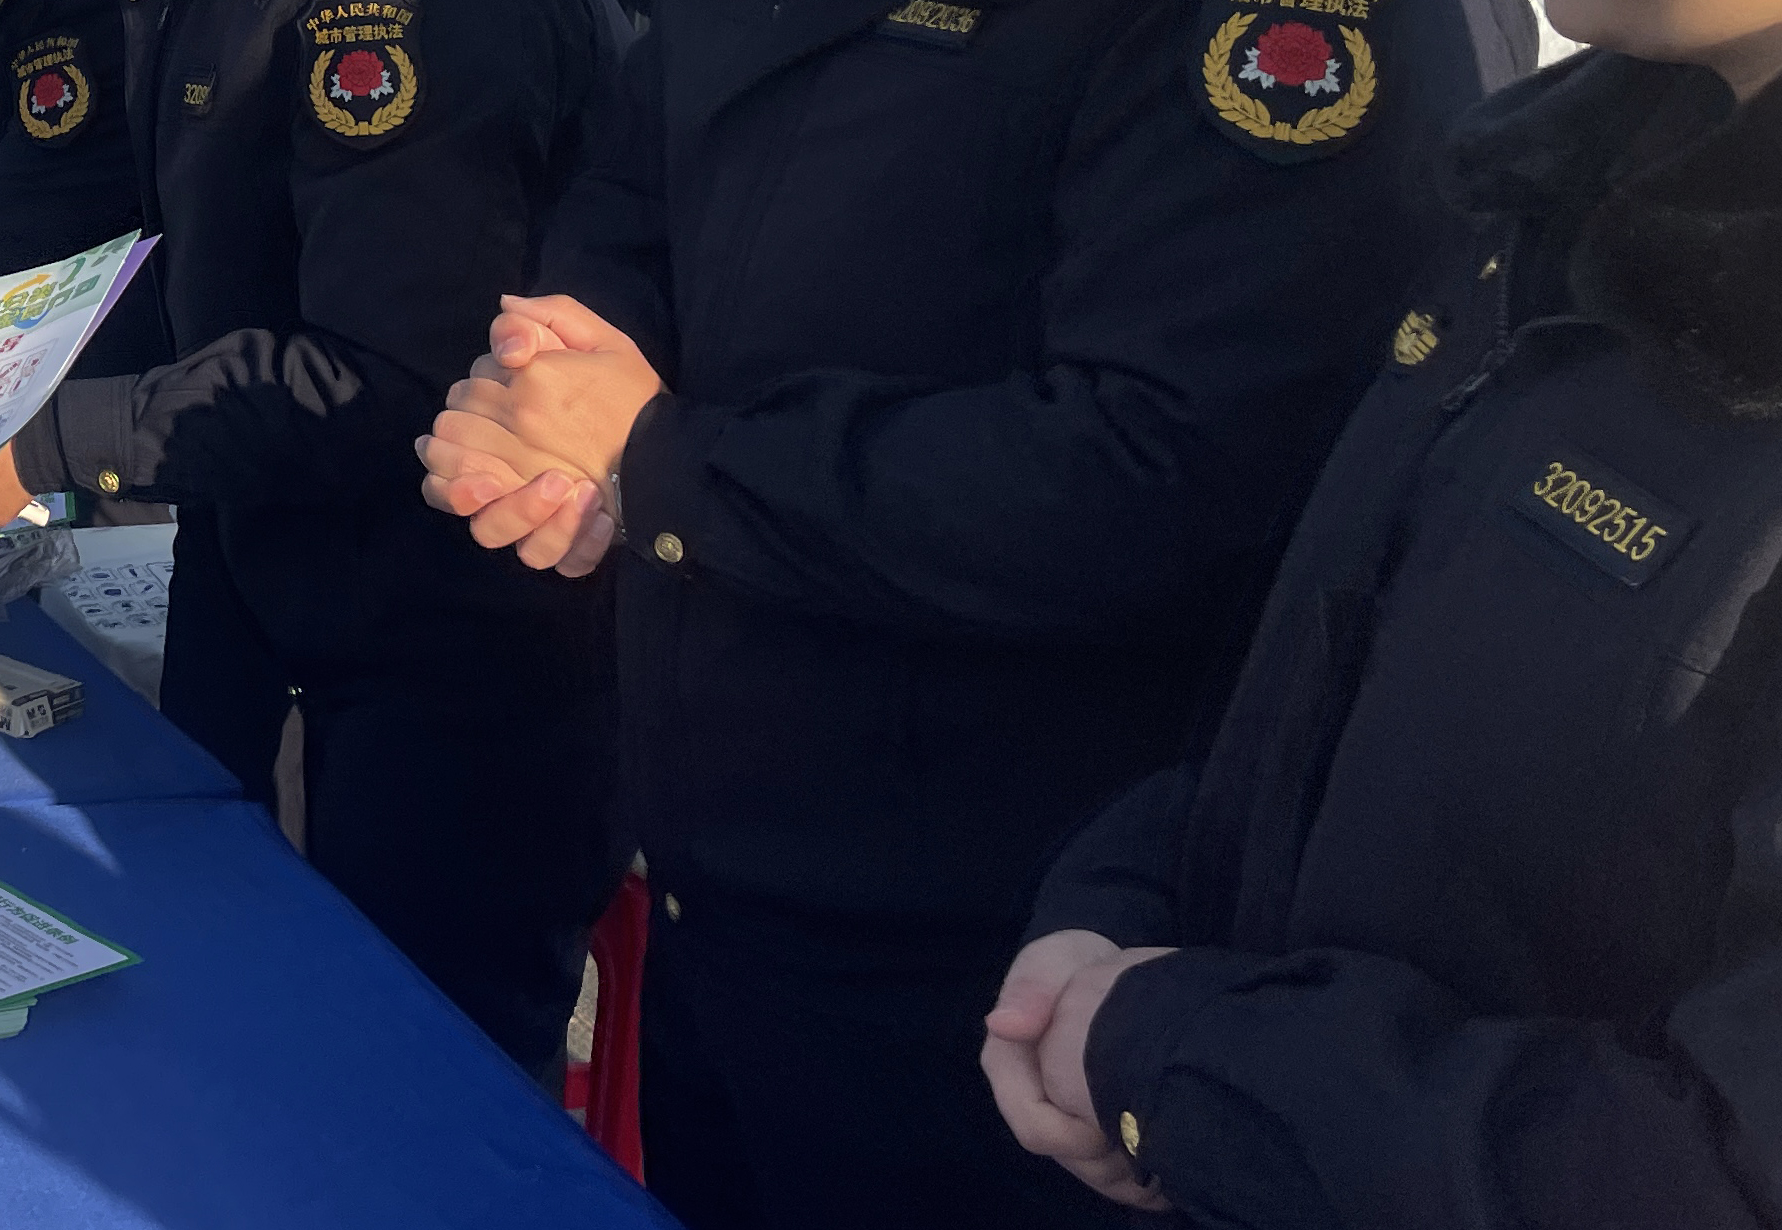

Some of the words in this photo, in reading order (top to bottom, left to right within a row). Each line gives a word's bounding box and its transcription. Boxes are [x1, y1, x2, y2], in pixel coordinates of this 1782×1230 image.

[306, 2, 414, 31] 中华人民共和国
[315, 24, 404, 44] 城市管理执法
[1534, 461, 1668, 561] 32092515
